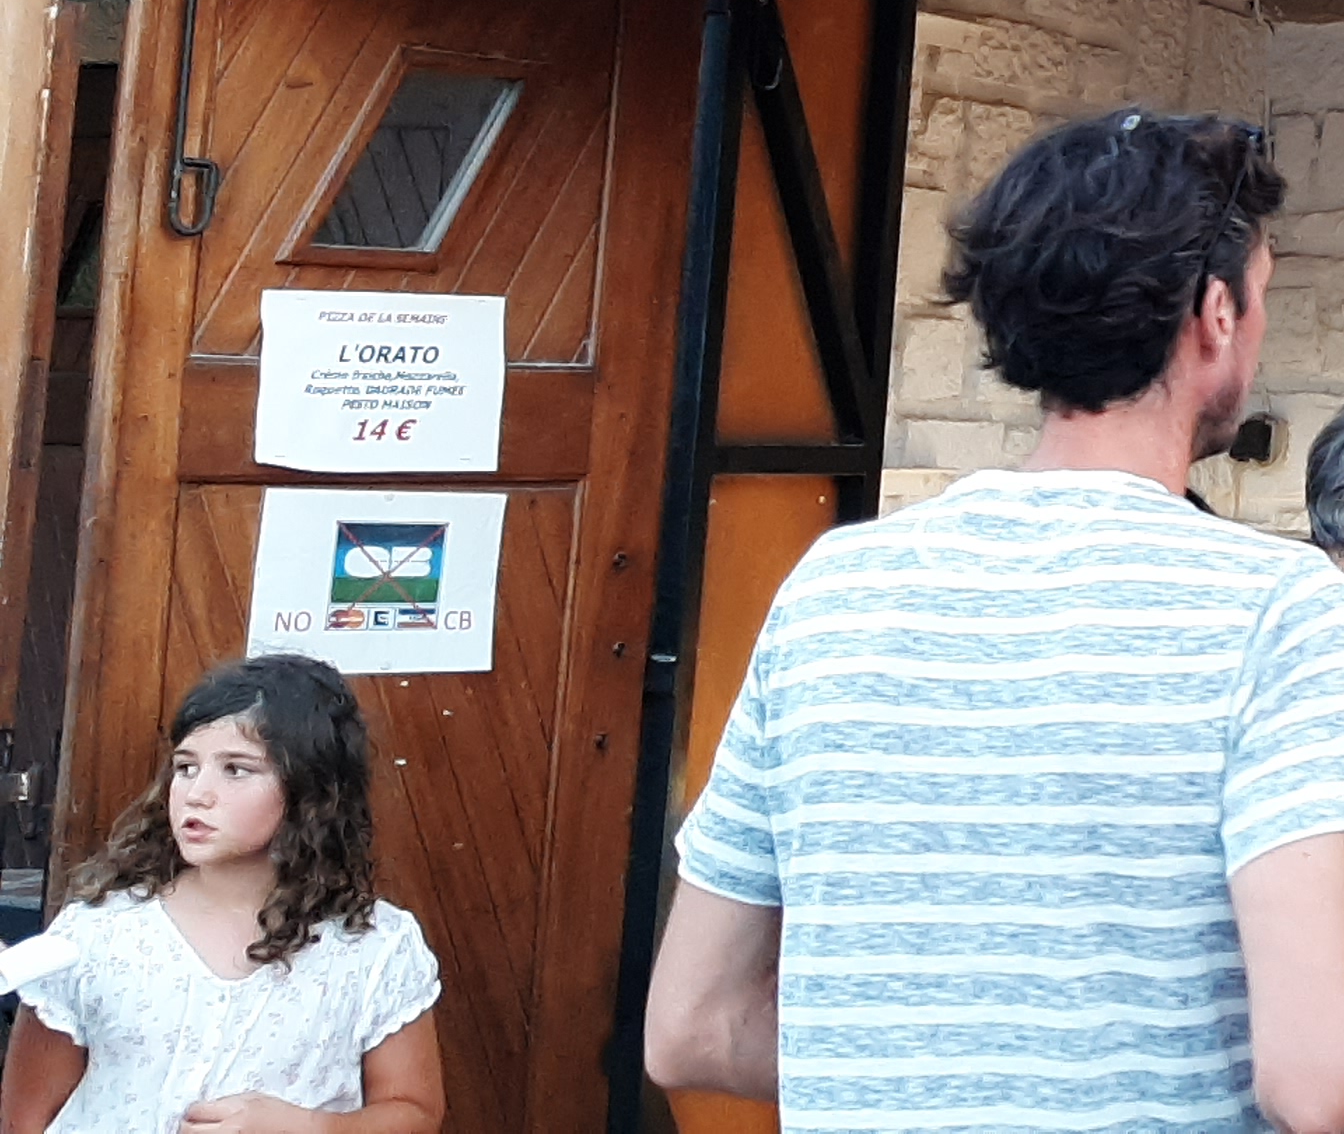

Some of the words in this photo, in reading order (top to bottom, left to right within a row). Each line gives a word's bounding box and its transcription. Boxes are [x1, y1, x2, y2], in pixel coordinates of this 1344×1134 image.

[339, 343, 439, 364] L'ORATO
[352, 419, 389, 441] 14
[395, 419, 417, 441] €
[274, 610, 312, 632] NO
[444, 610, 472, 631] CB
